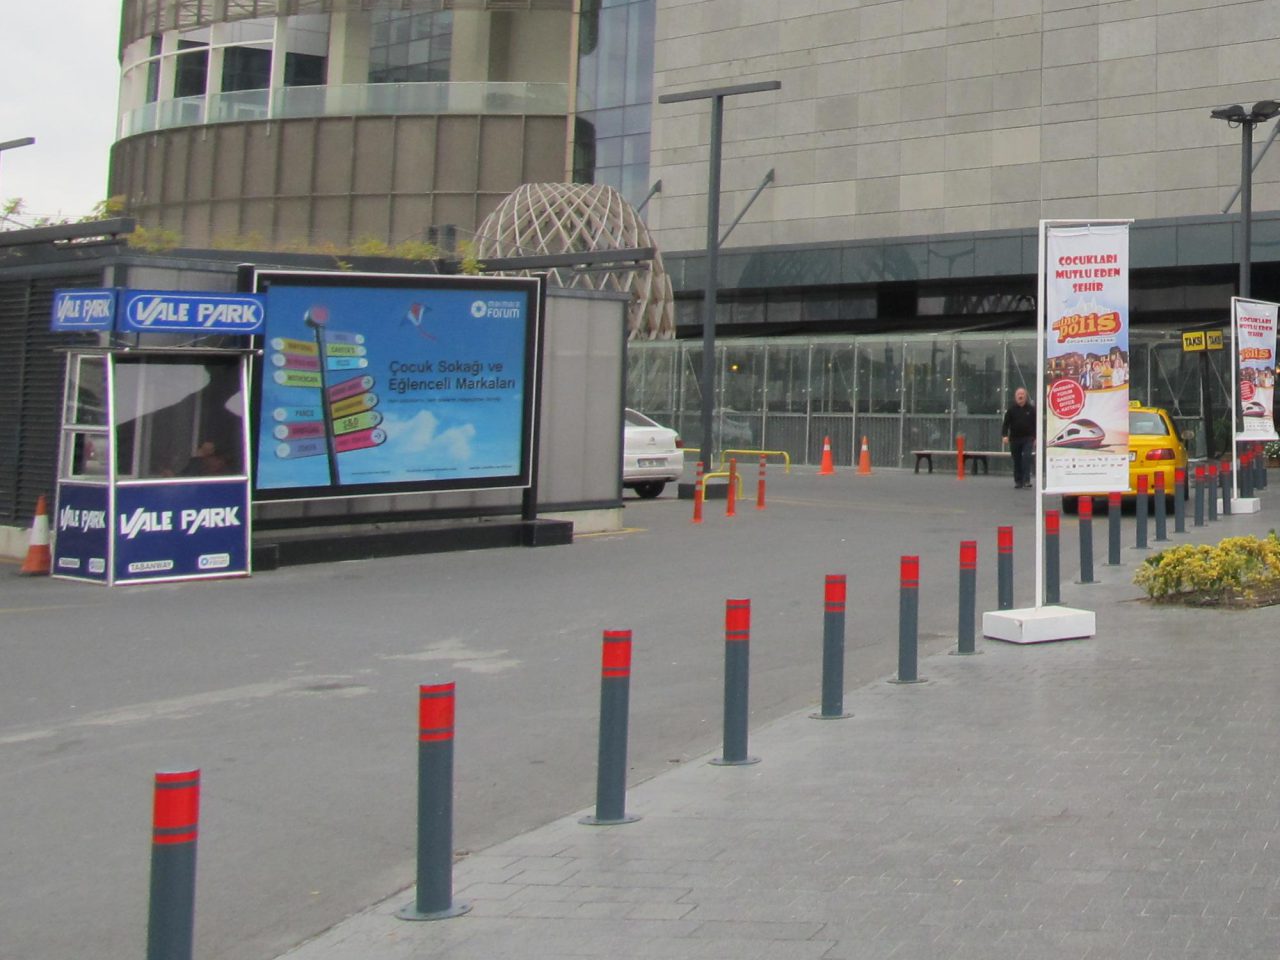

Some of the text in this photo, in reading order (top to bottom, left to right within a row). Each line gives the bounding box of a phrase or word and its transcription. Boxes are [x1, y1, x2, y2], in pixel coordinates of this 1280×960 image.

[1055, 268, 1121, 279] MUTLU EDEN
[57, 295, 111, 322] VALE PARK
[136, 297, 257, 327] VALE PARK
[389, 361, 503, 376] Çocuk Sokağı ve
[388, 378, 515, 394] Eğlenceli Markaları
[60, 505, 106, 532] VALE PARK
[120, 506, 241, 540] VALE PARK
